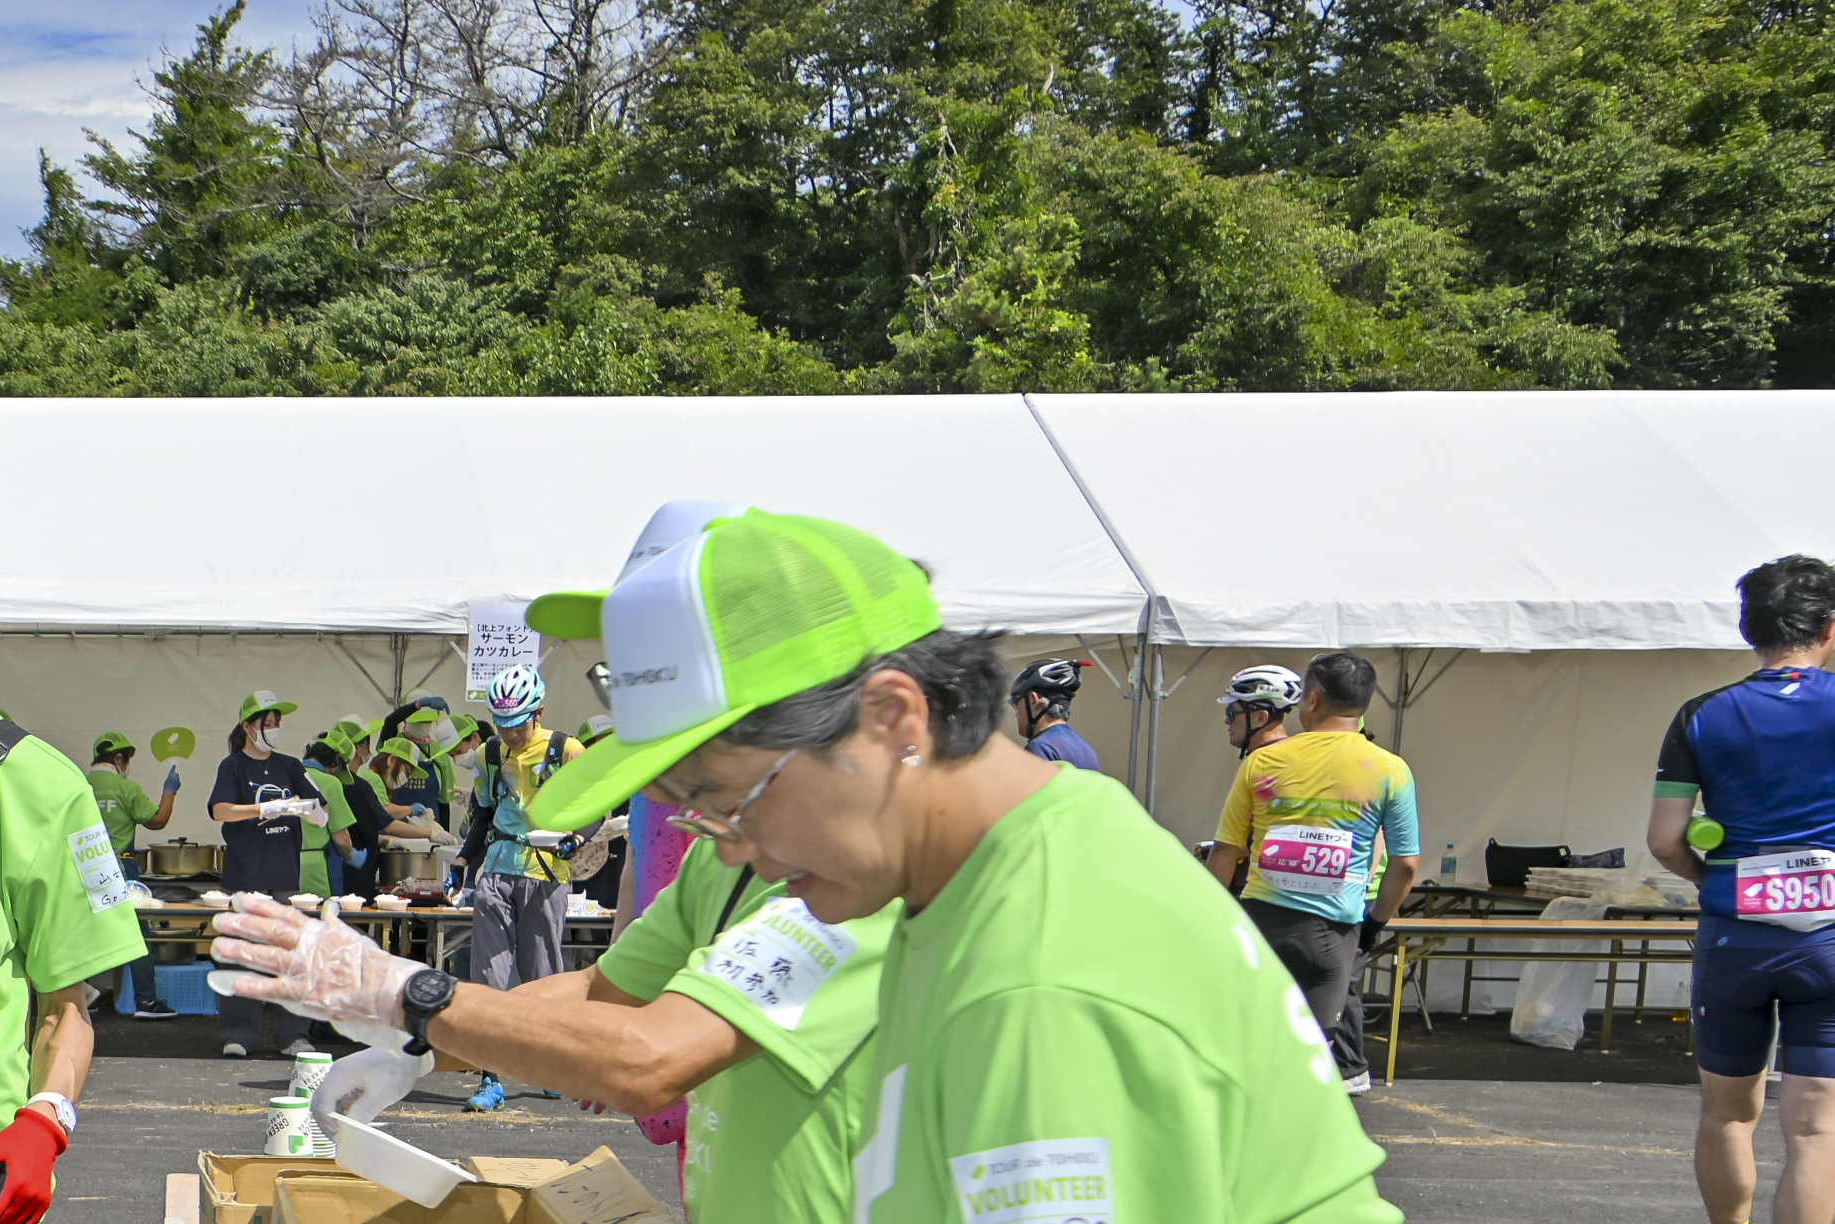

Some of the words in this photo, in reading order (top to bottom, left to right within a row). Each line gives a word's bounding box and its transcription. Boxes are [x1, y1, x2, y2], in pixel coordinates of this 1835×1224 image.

[481, 633, 528, 644] サーモン
[474, 646, 533, 657] カツカレー
[84, 831, 101, 842] TOUR
[1299, 831, 1349, 842] LINEヤフー
[1301, 846, 1345, 875] 529
[267, 1118, 289, 1138] GREEN
[989, 1158, 1022, 1175] TOUR
[966, 1175, 1108, 1215] VOLUNTEER
